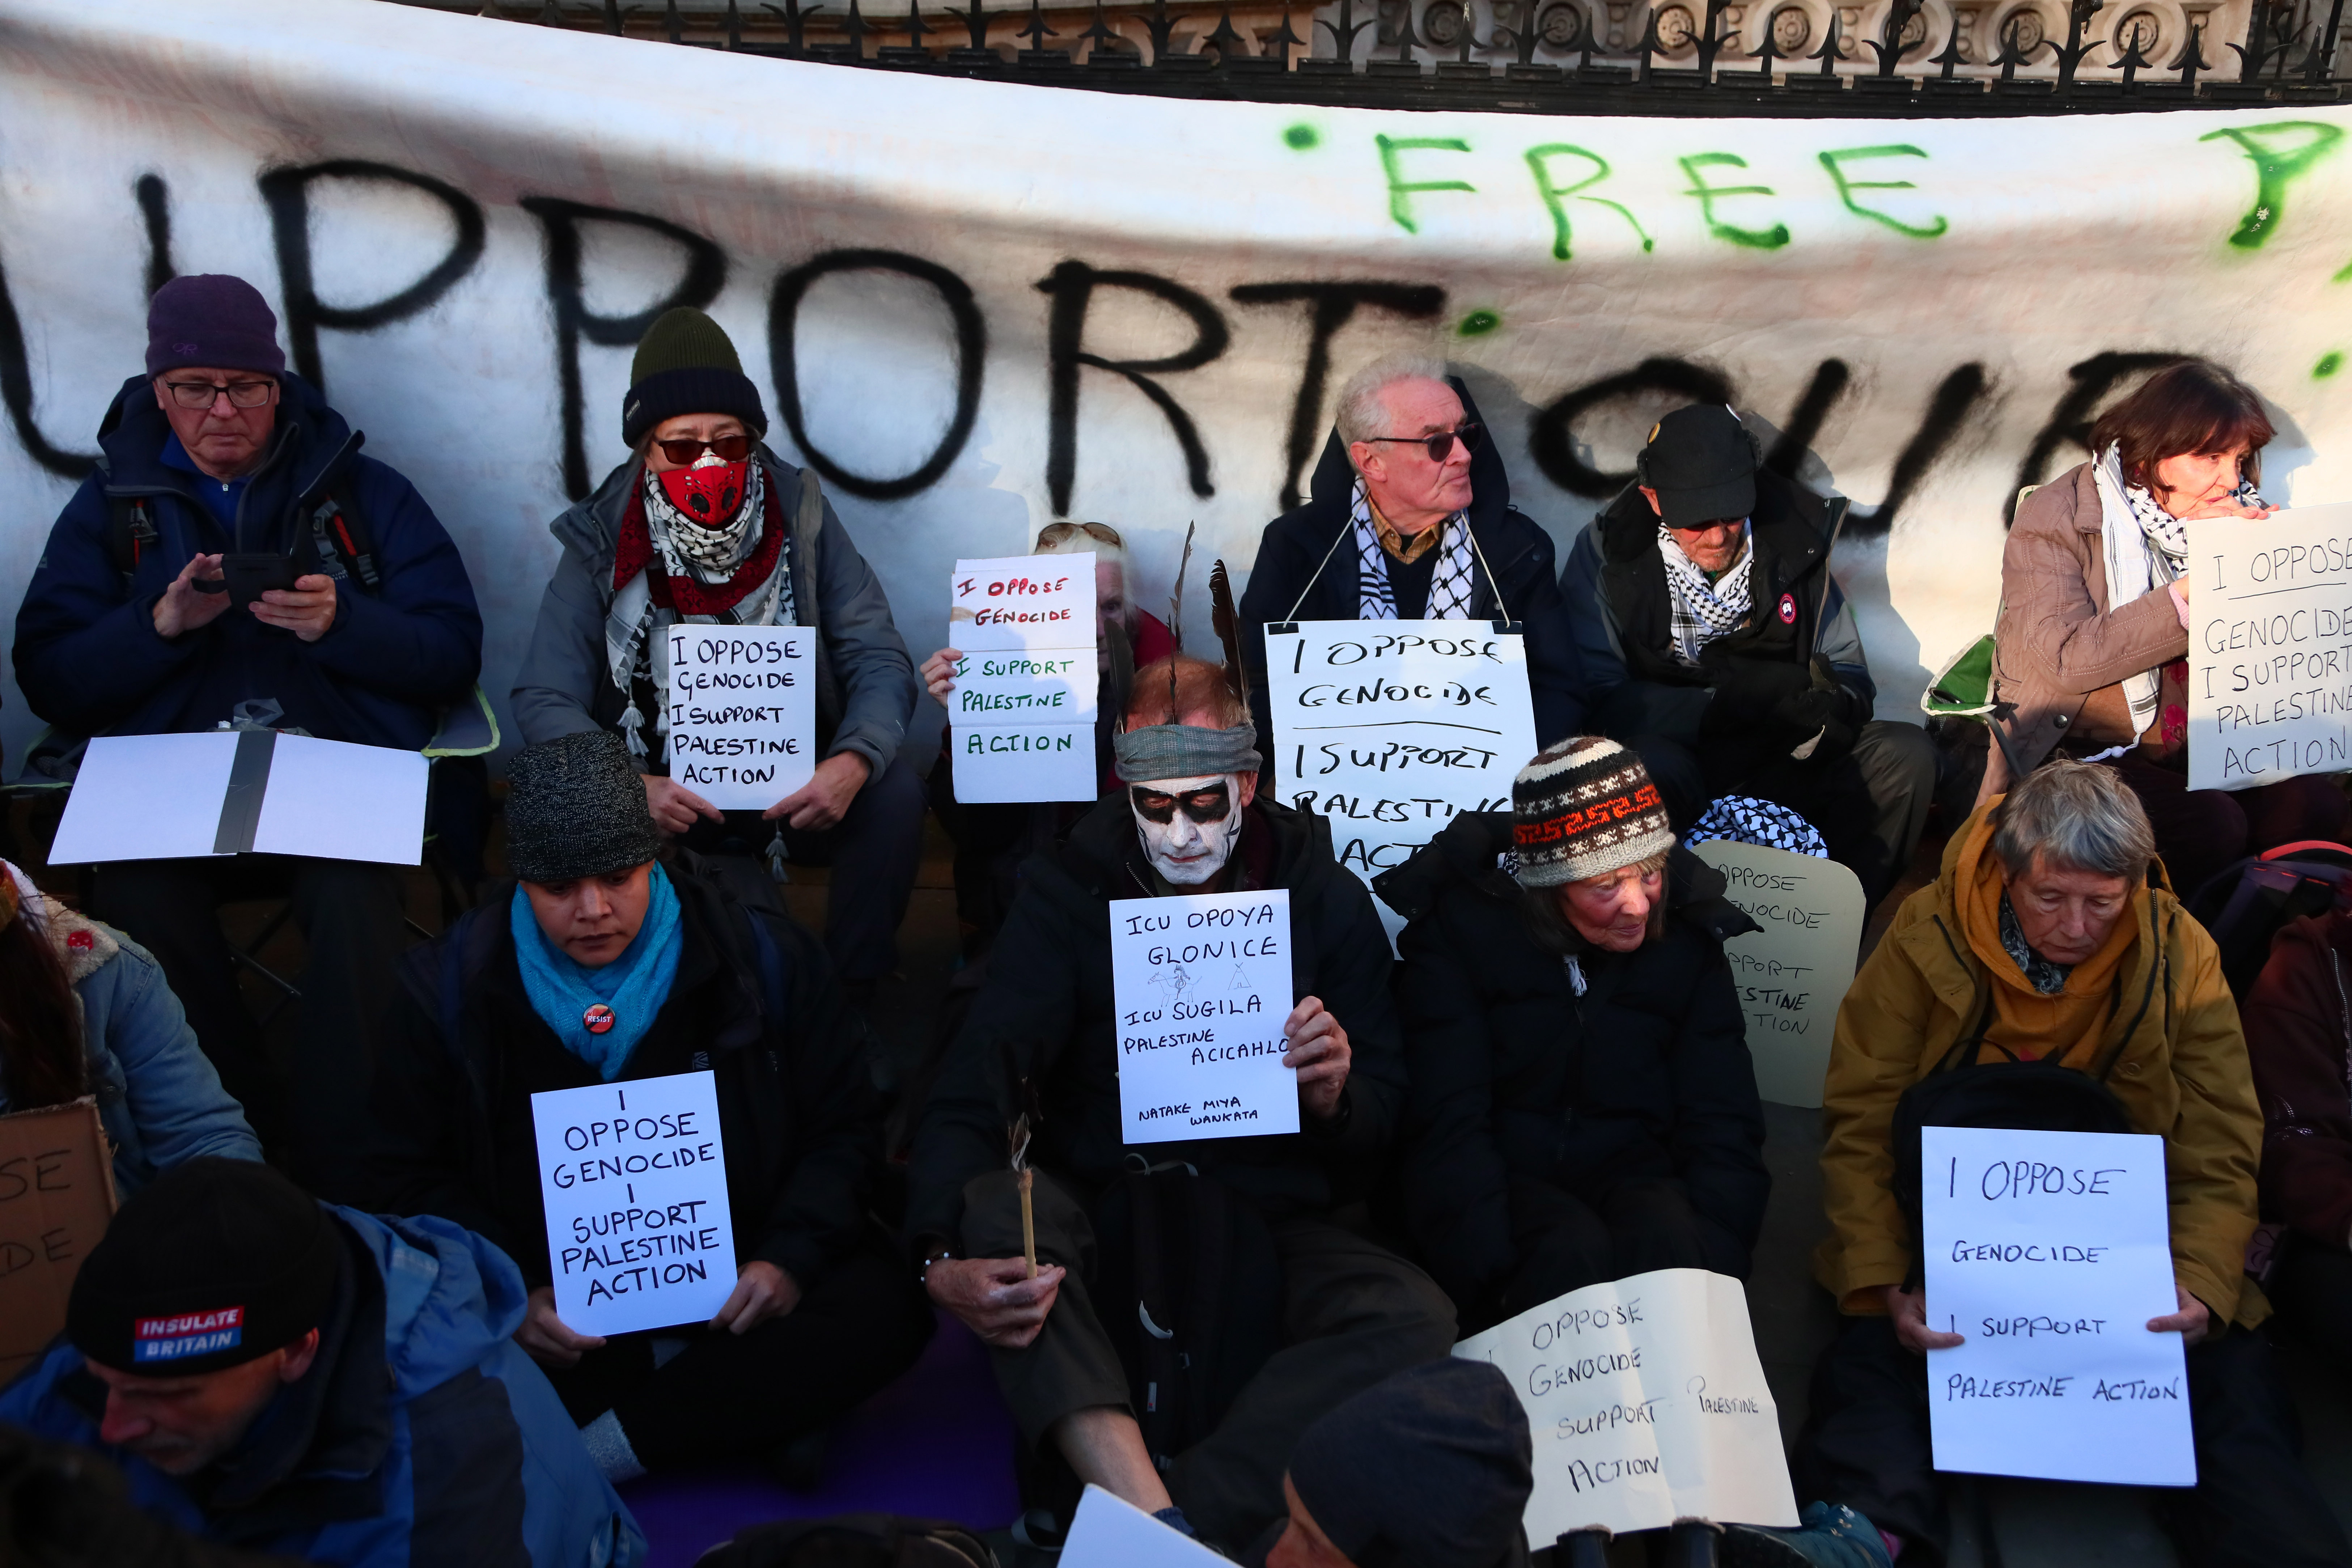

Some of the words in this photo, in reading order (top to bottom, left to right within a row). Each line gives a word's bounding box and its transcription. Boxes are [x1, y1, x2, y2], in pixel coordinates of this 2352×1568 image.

[1376, 132, 1948, 260] FREE
[958, 578, 976, 597] I
[988, 577, 1069, 596] OPPOSE
[2212, 555, 2226, 590] I
[975, 608, 1071, 626] GENOCIDE
[671, 636, 688, 666] I
[698, 639, 802, 665] OPPOSE
[1294, 639, 1305, 674] I
[1327, 635, 1503, 666] OPPOSE
[956, 657, 970, 677] I
[982, 660, 1074, 676] SUPPORT
[678, 671, 795, 701] GENOCIDE
[1298, 678, 1498, 707] GENOCIDE
[2200, 666, 2216, 699] I
[672, 704, 685, 726] I
[689, 706, 784, 725] SUPPORT
[962, 690, 1066, 712] PALESTINE
[673, 734, 800, 756] PALESTINE
[967, 733, 1072, 754] ACTION
[2224, 725, 2345, 778] ACTION
[683, 763, 775, 784] ACTION
[1296, 744, 1304, 778] I
[1320, 742, 1499, 775] SUPPORT
[1292, 790, 1509, 822] PALESTI
[1126, 915, 1170, 935] ICU
[1187, 904, 1273, 928] OPOYA
[1731, 900, 1830, 928] NOCIDE
[1148, 936, 1276, 965] GLONICE
[1728, 952, 1813, 979] PPORT
[1124, 1010, 1162, 1026] ICU
[1173, 994, 1261, 1020] SUGILA
[1124, 1029, 1215, 1054] PALESTINE
[619, 1090, 625, 1110] I
[1139, 1102, 1191, 1121] NATAKE
[1203, 1096, 1241, 1110] MIYA
[565, 1112, 699, 1151] OPPOSE
[1190, 1110, 1258, 1126] WANKATA
[554, 1142, 715, 1188] GENOCIDE
[1950, 1157, 1956, 1198] I
[1982, 1160, 2127, 1200] OPPOSE
[627, 1183, 635, 1203] I
[573, 1200, 706, 1244] SUPPORT
[561, 1227, 720, 1274] PALESTINE
[1952, 1240, 2109, 1263] GENOCIDE
[587, 1259, 707, 1306] ACTION
[142, 1308, 239, 1336] INSULATE
[1532, 1297, 1643, 1350] OPPOSE
[1982, 1315, 2107, 1338] SUPPORT
[145, 1331, 233, 1357] BRITAIN
[1529, 1347, 1642, 1397] GENOCIDE
[1947, 1373, 2074, 1402] PALESTINE
[2092, 1377, 2179, 1402] ACTION
[1556, 1397, 1666, 1440] SUPPORT
[1687, 1375, 1758, 1414] PALESTINE
[1568, 1456, 1659, 1493] ACTION
